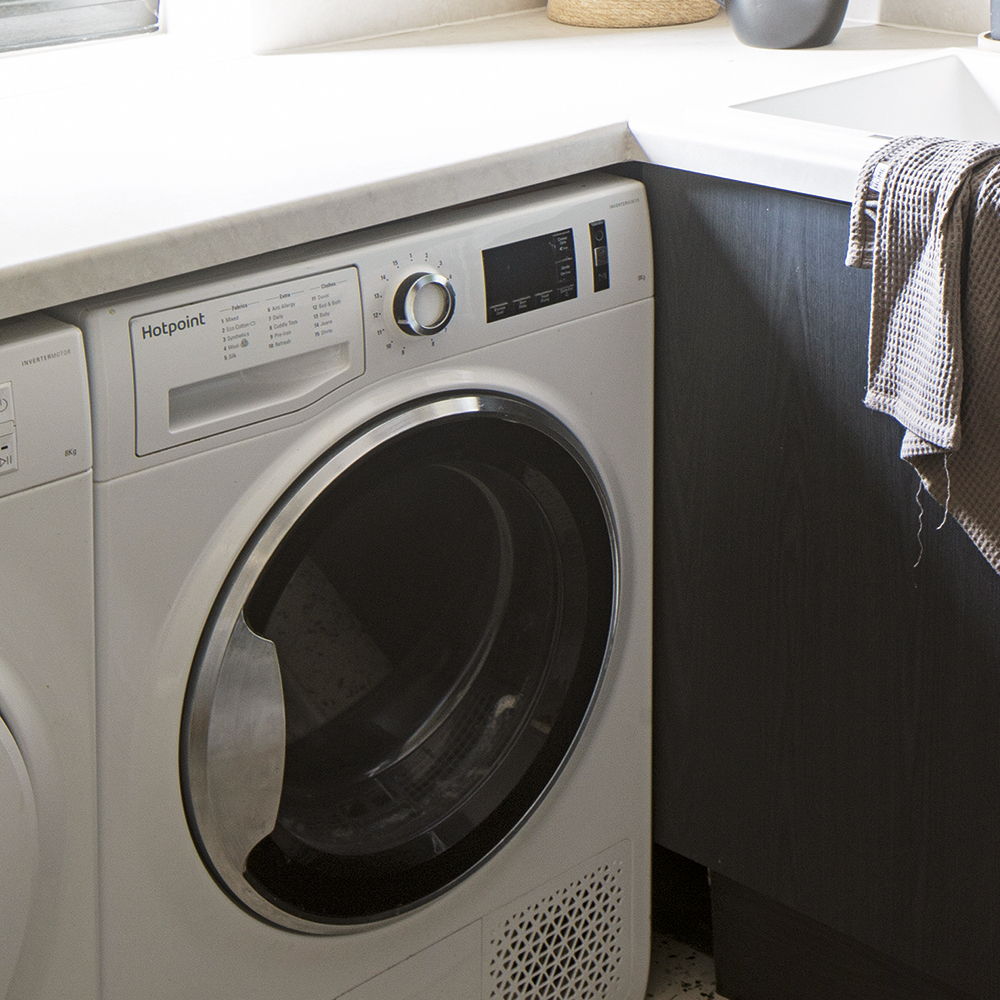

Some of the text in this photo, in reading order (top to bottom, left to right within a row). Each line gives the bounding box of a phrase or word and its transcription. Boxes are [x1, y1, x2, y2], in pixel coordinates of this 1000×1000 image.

[141, 312, 206, 340] Hotpoint
[21, 348, 71, 366] INVERTERMOTOR
[64, 448, 77, 457] 8Kg
